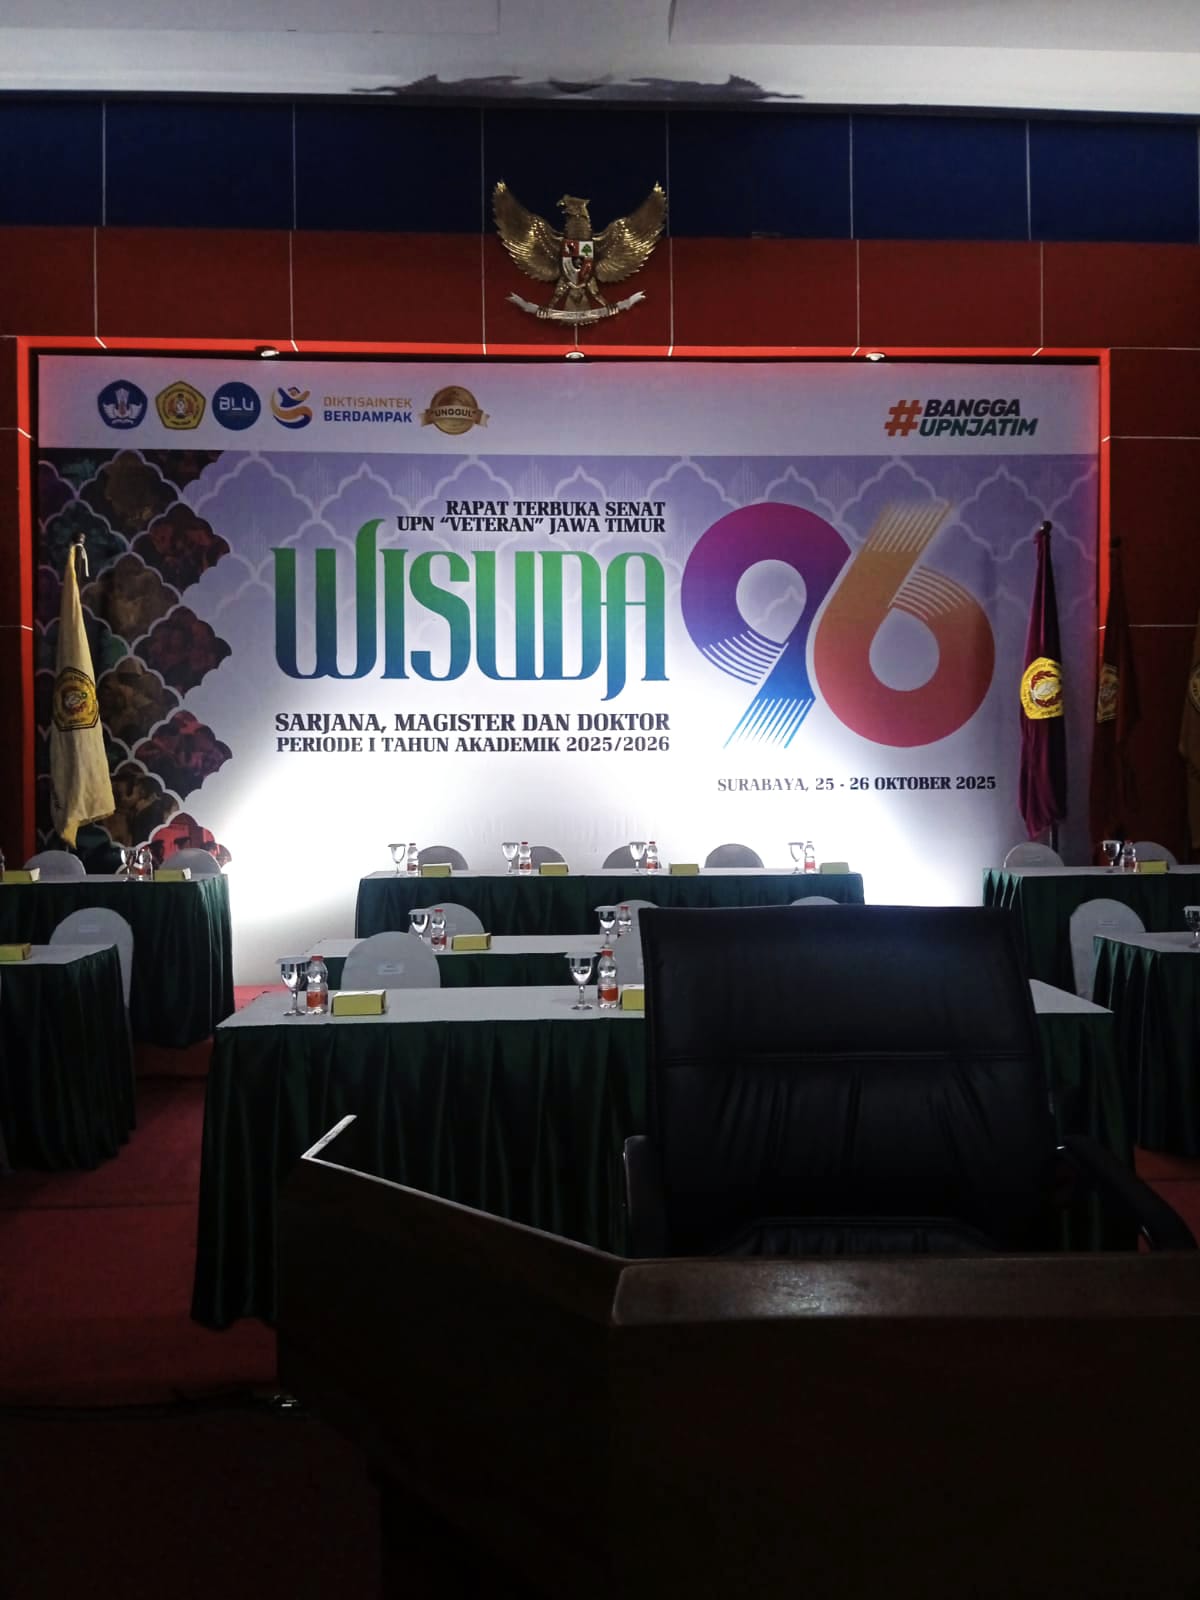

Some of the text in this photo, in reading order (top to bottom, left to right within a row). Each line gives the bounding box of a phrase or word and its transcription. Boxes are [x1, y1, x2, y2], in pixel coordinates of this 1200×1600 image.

[219, 396, 254, 411] BLU
[323, 410, 412, 423] BERDAMPAK
[919, 418, 1038, 437] UPNJATIM
[446, 500, 666, 516] RAPAT TERBUKA SENAT
[397, 516, 434, 531] UPN
[548, 518, 601, 534] JAWA
[604, 518, 666, 532] TIMUR
[270, 499, 996, 749] WISUDA 96
[275, 713, 670, 734] SARJANA, MAGISTER DAN DOKTOR
[276, 736, 670, 752] PERIODE I TAHUN AKADEMIK 2025/2026
[717, 777, 809, 792] SURABAYA,
[815, 777, 835, 791] 25
[850, 776, 870, 791] 26
[874, 776, 951, 790] OKTOBER
[955, 775, 996, 790] 2025
